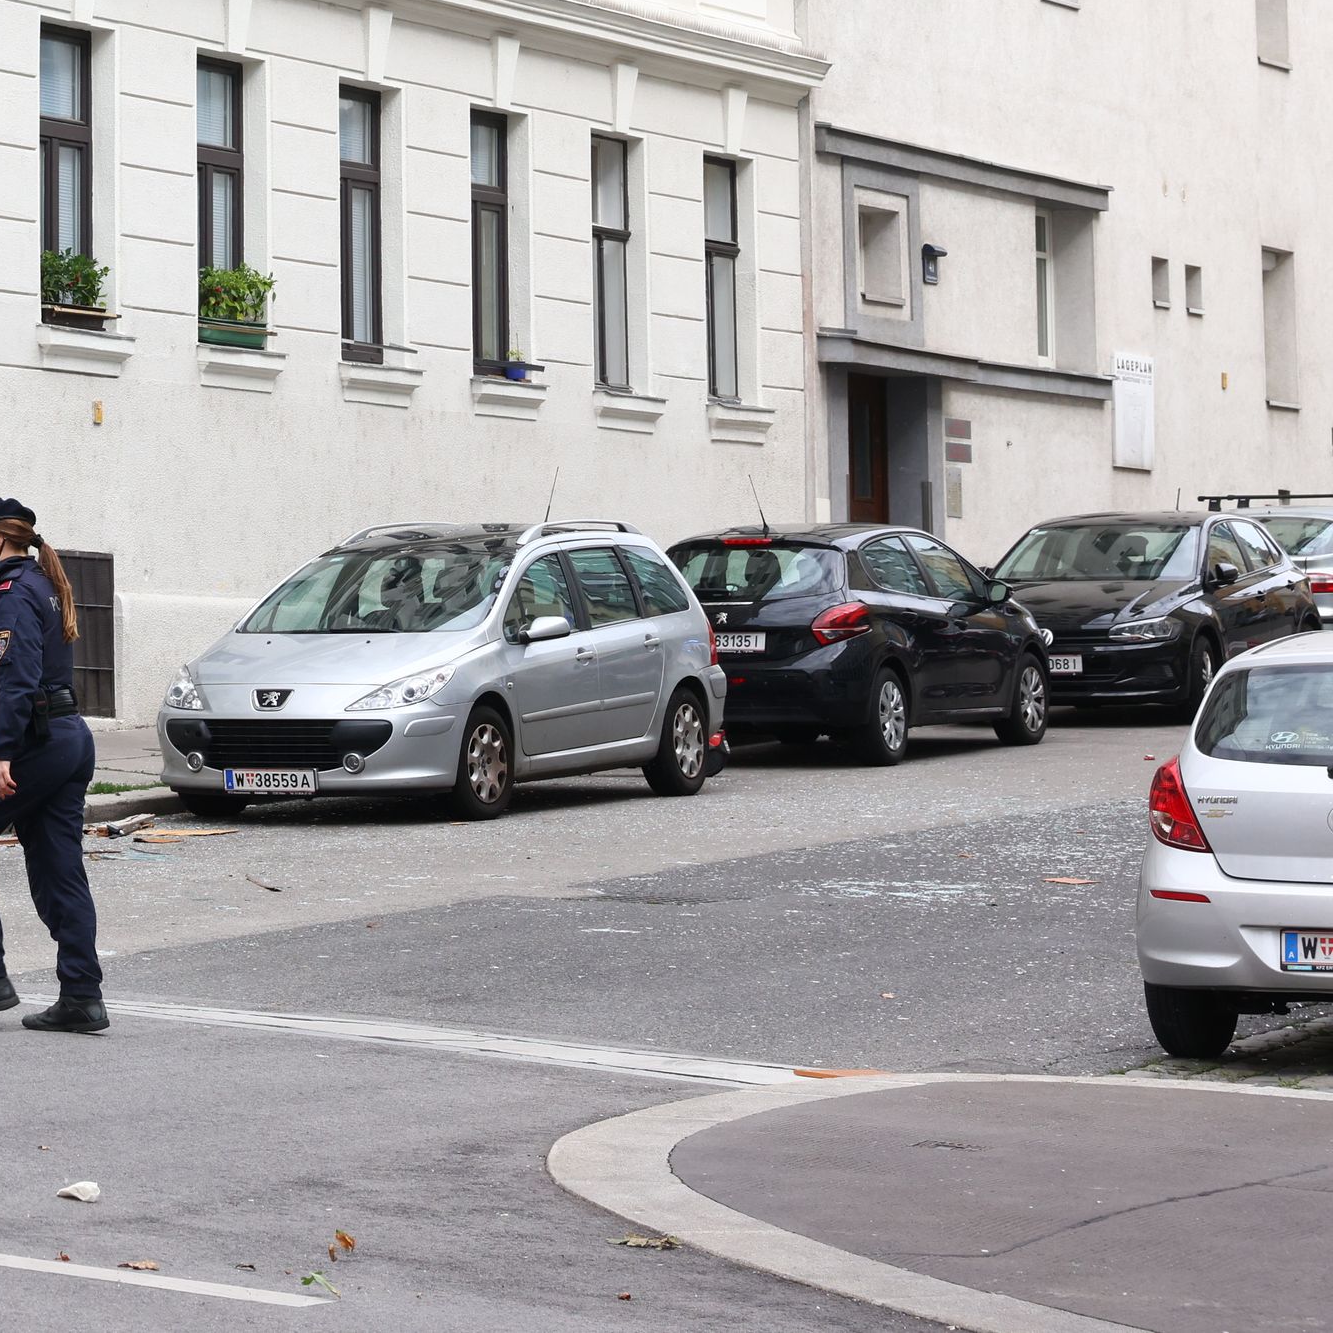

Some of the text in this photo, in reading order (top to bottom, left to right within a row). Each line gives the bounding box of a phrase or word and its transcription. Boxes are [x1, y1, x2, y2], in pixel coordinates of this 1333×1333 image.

[1116, 357, 1153, 374] LAGEPLAN
[235, 773, 311, 788] W 38559 A
[1197, 795, 1239, 805] HYUNDAI
[1301, 937, 1318, 960] W
